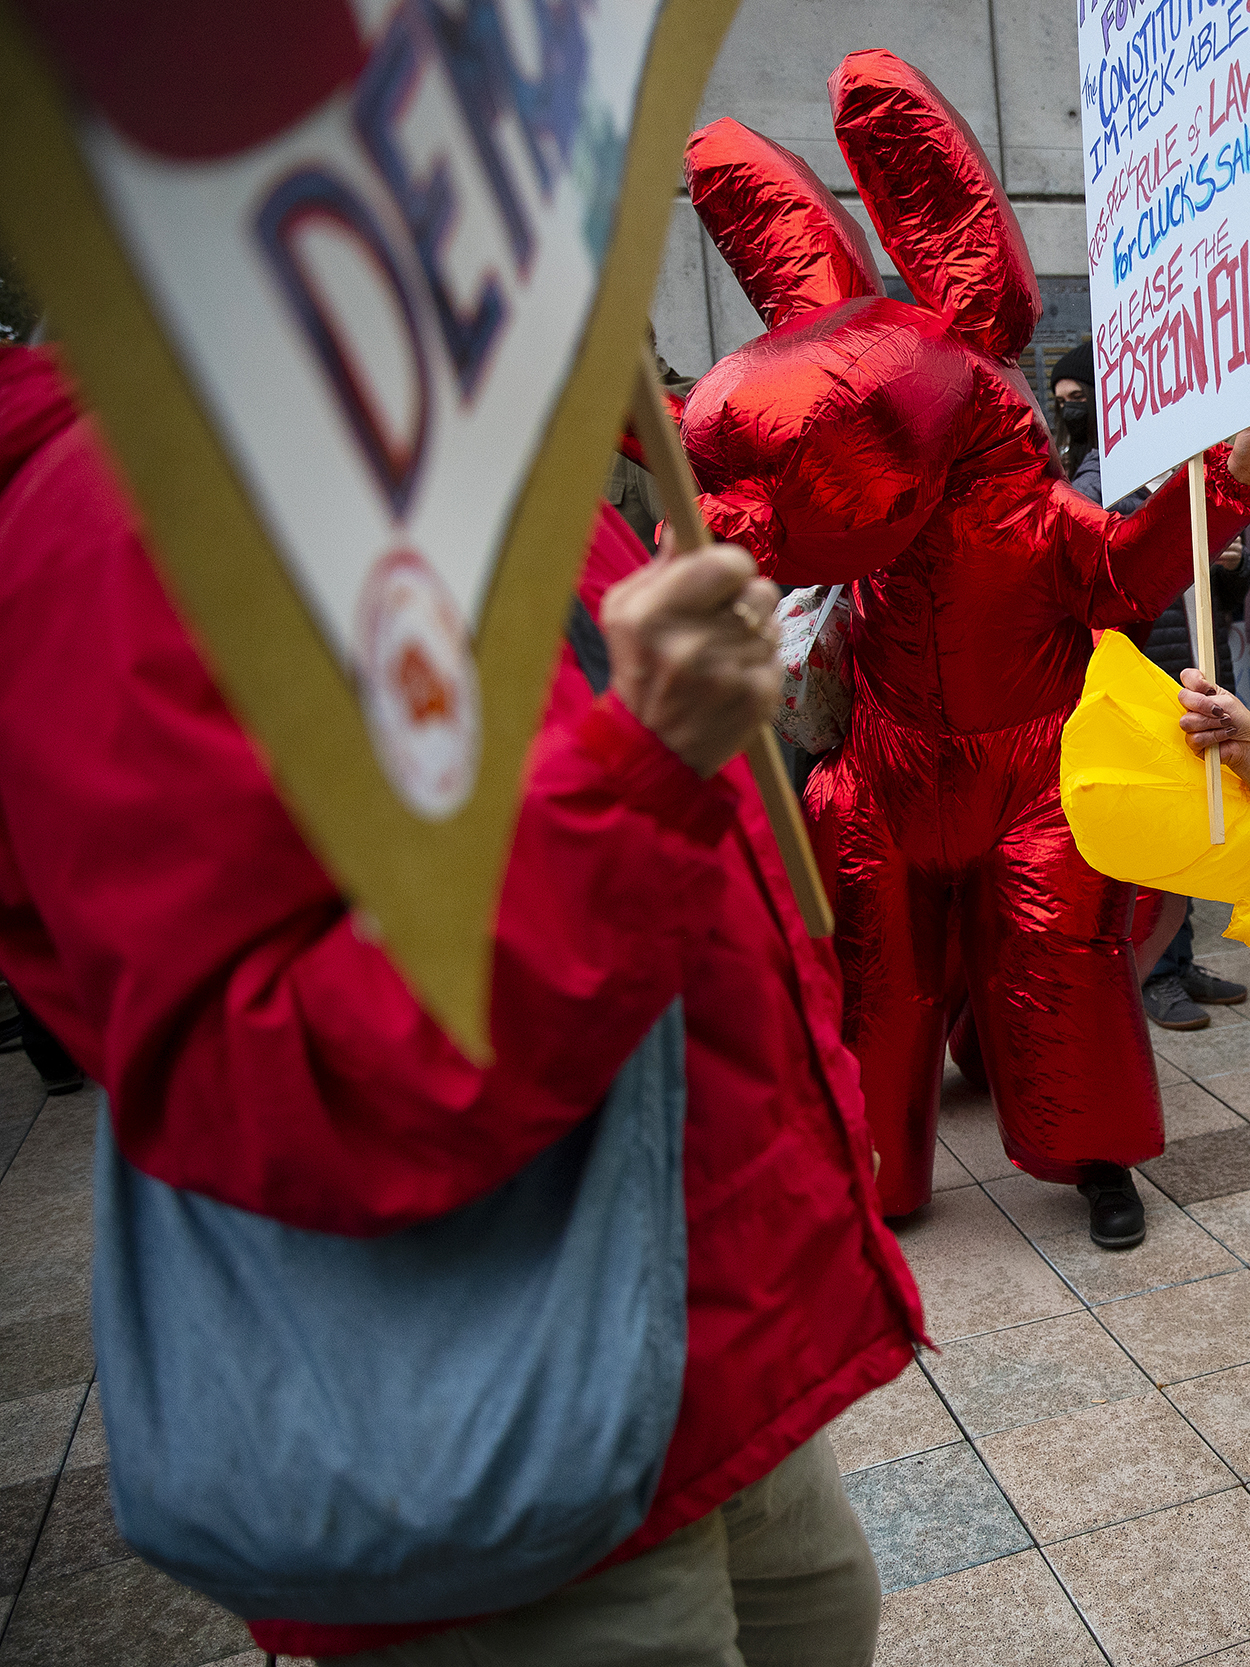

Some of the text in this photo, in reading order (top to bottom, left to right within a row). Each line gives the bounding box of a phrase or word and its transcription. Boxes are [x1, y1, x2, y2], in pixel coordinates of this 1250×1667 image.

[1099, 0, 1226, 129] CONSTITU
[1135, 123, 1183, 210] RULE
[1188, 105, 1203, 156] of
[1096, 217, 1232, 369] RELEASE THE
[1101, 285, 1208, 458] EPSTEIN
